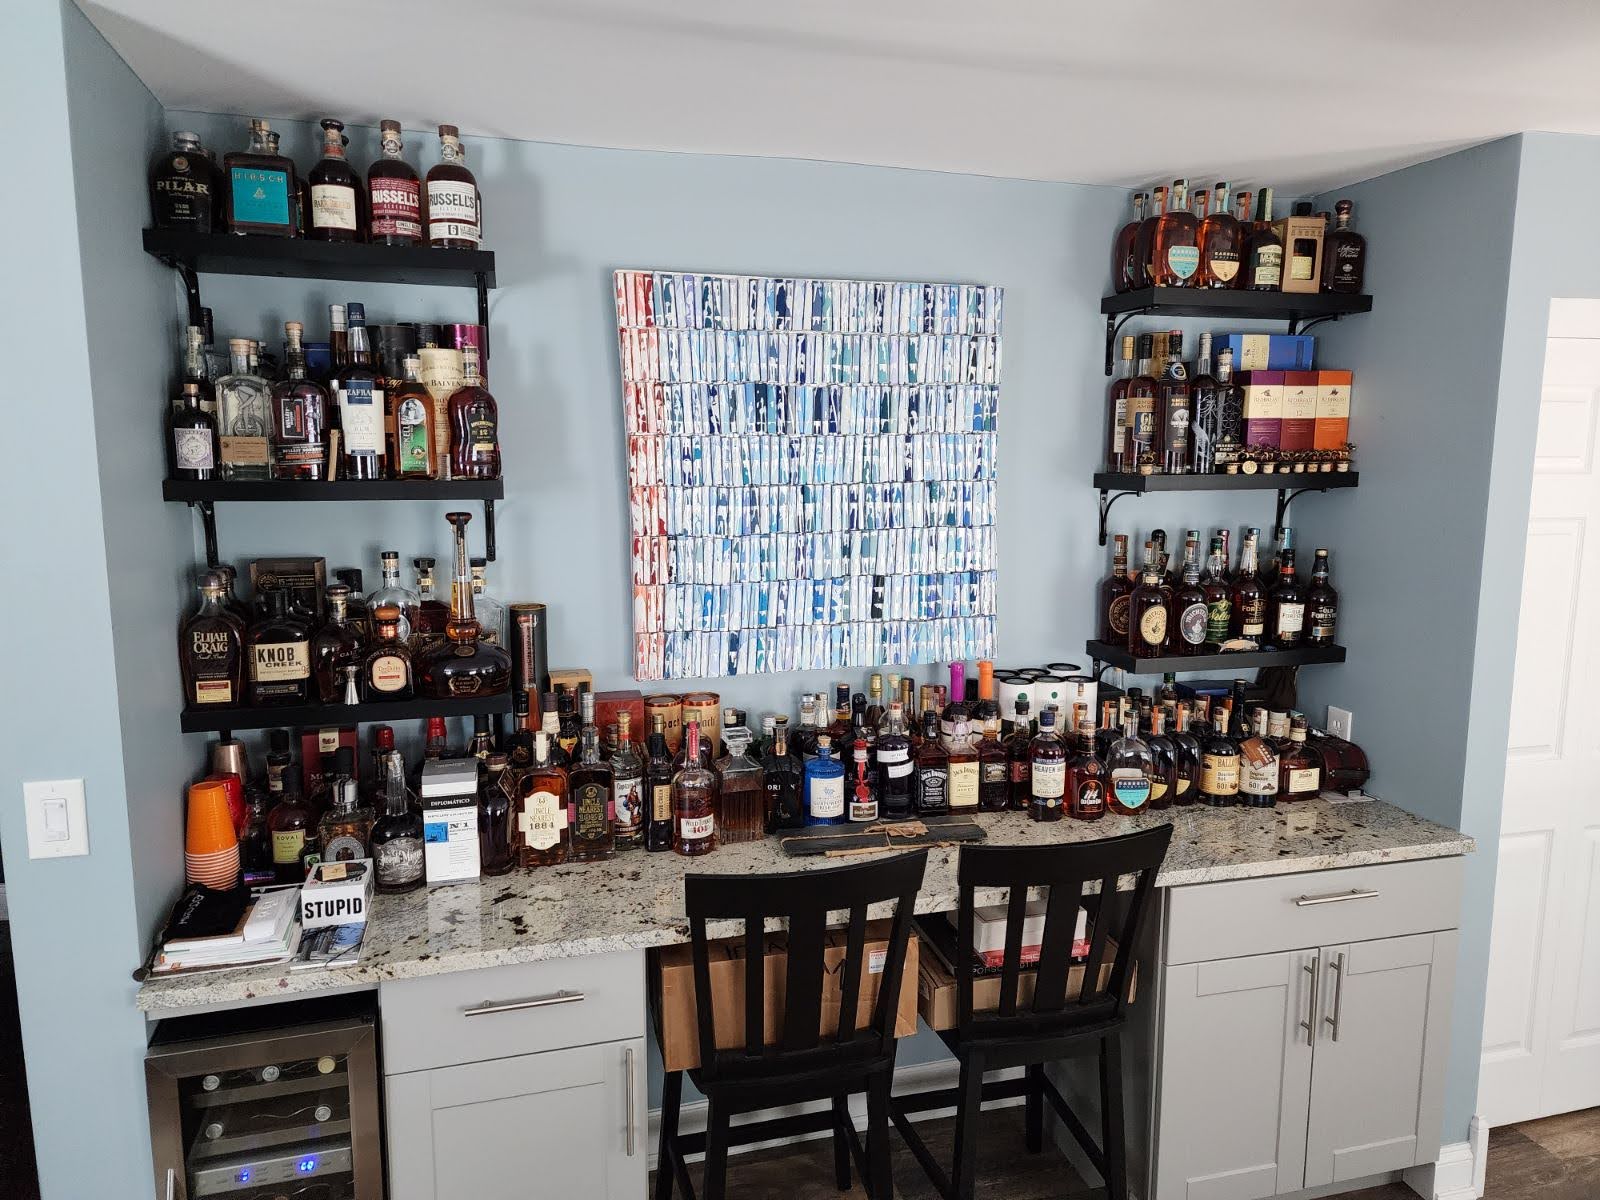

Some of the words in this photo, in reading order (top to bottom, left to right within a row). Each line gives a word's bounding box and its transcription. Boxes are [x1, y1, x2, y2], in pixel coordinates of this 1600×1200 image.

[234, 172, 284, 184] HIRSCH
[157, 181, 209, 195] PILAR
[372, 189, 419, 208] RUSSELL'S
[430, 193, 475, 209] RUSSELL'S
[348, 388, 371, 396] ZAFRA
[192, 631, 228, 643] ELIJAH
[193, 641, 228, 654] CRAIG
[257, 647, 295, 663] KNOB
[952, 768, 963, 778] JACK
[1034, 764, 1055, 772] HEAVEN
[920, 771, 931, 780] JACK
[431, 798, 470, 807] DIPLOMÁTICO
[529, 822, 554, 830] 1884
[686, 820, 698, 828] WILD
[693, 826, 708, 834] 101
[304, 898, 362, 920] STUPID
